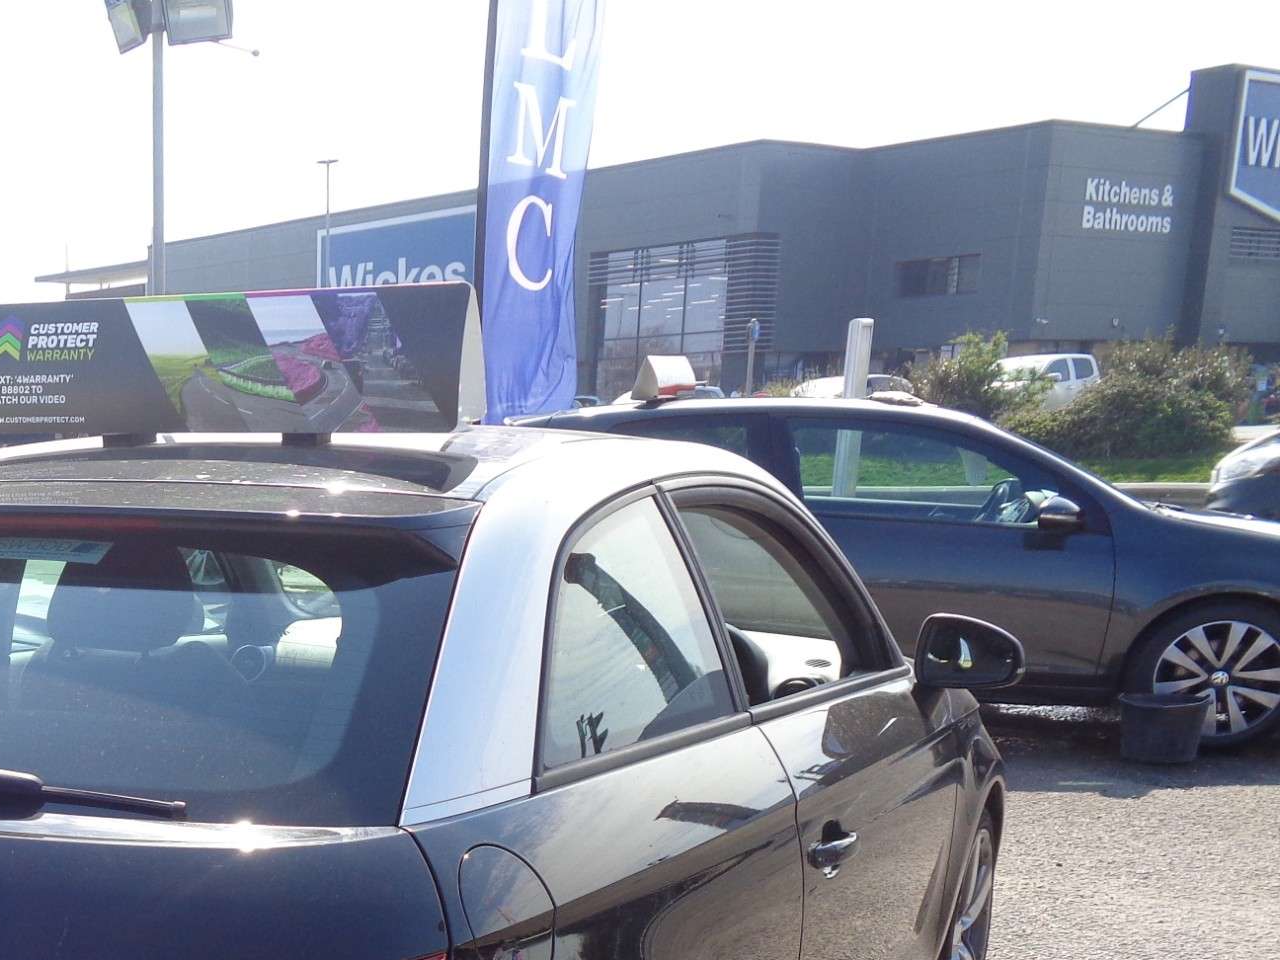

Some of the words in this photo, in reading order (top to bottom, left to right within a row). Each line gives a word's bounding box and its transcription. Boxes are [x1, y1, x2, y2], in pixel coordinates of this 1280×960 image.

[1085, 178, 1159, 206] Kitchens
[1161, 184, 1174, 207] &
[1082, 205, 1172, 233] Bathrooms
[30, 322, 99, 334] CUSTOMER
[28, 334, 97, 348] PROTECT
[27, 348, 95, 361] WARRANTY
[20, 396, 38, 404] OUR
[39, 395, 66, 404] VIDEO
